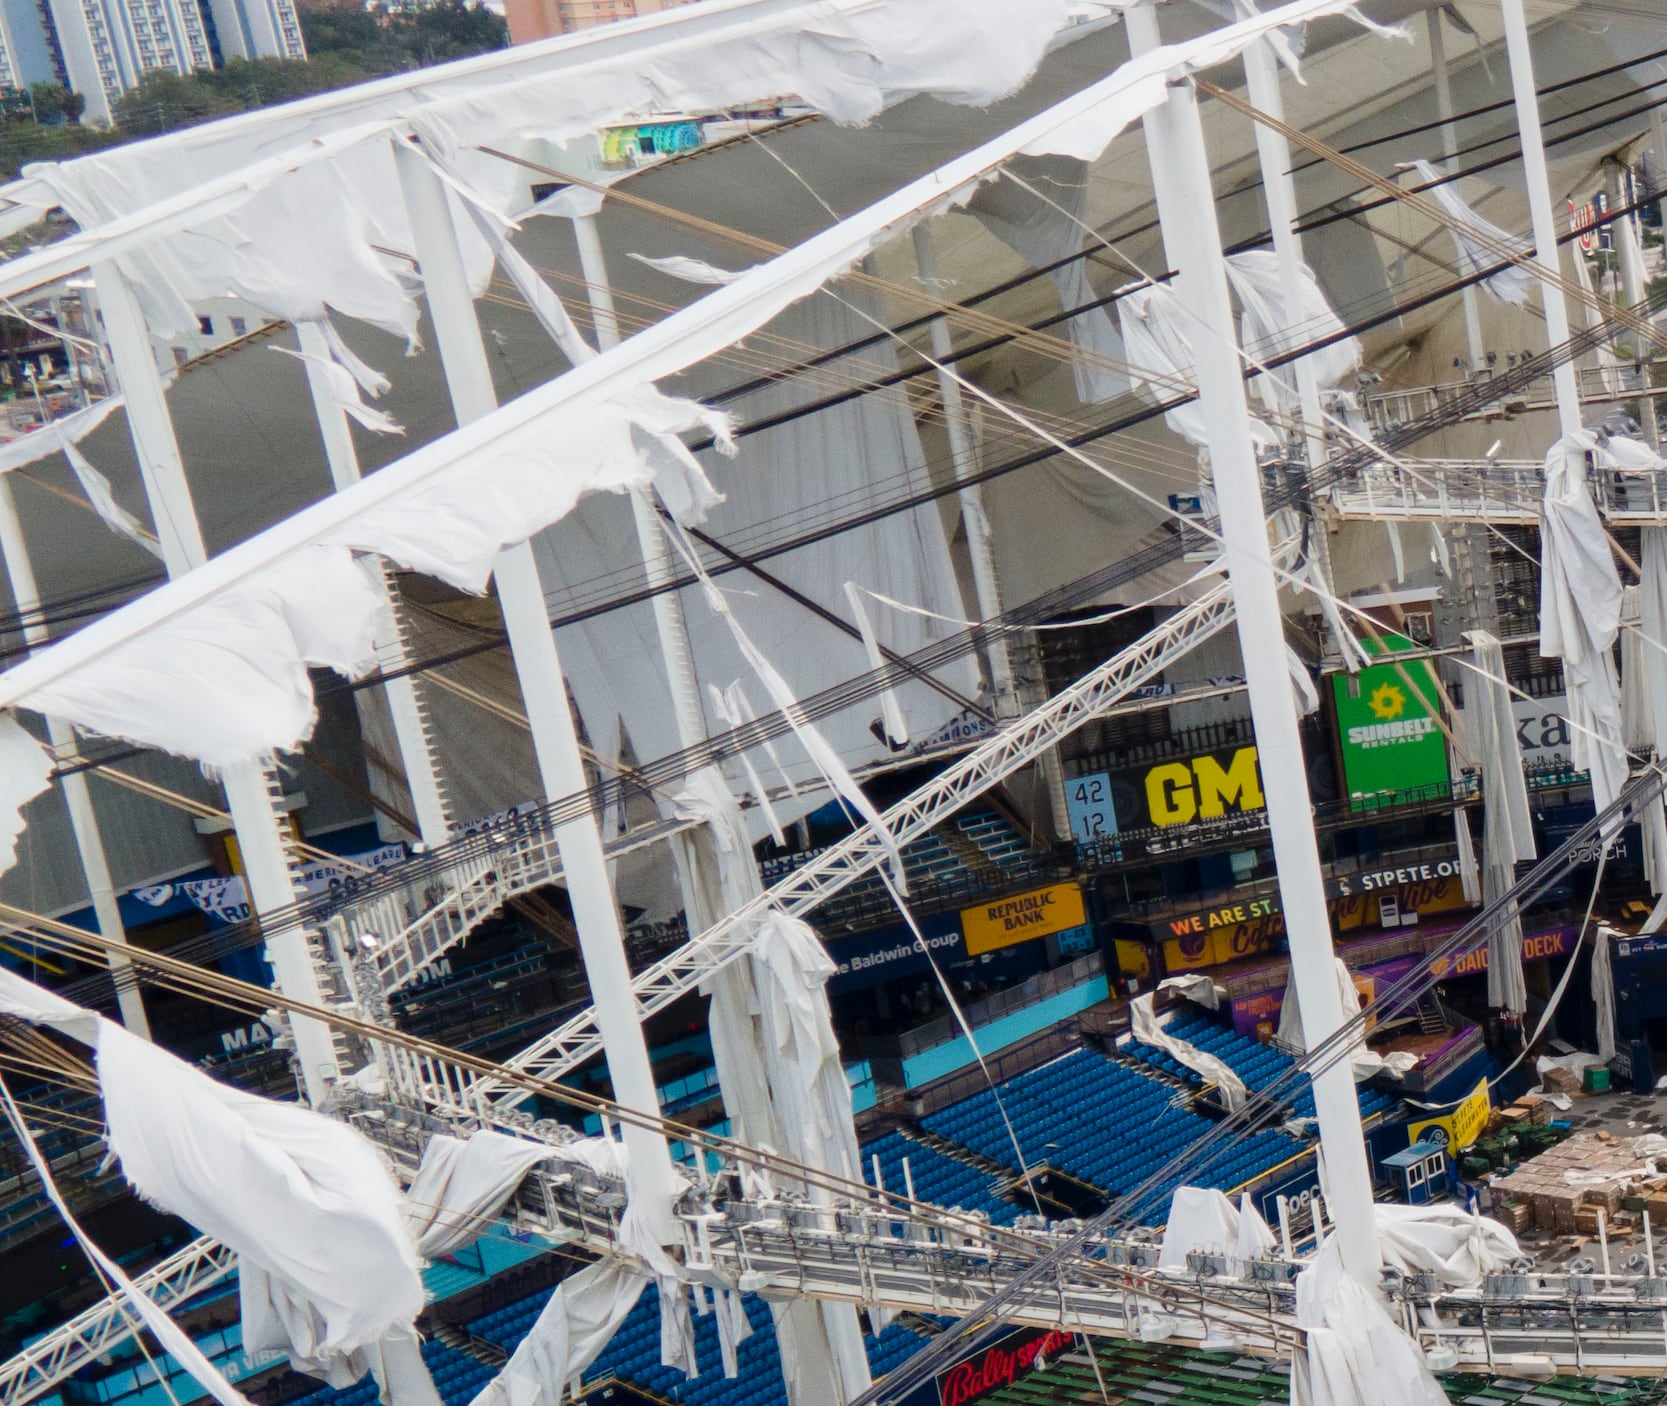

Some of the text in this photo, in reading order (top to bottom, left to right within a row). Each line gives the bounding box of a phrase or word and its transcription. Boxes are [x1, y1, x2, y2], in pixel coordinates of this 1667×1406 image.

[1347, 717, 1436, 745] SUNBELT
[1361, 734, 1424, 749] RENTALS
[1075, 779, 1104, 806] 42
[1144, 746, 1265, 829] GM
[987, 890, 1056, 921] REPUBLIC
[1004, 908, 1045, 931] BANK
[1170, 899, 1279, 936] WE ARE ST.
[851, 944, 911, 971] Baldwin
[913, 931, 960, 953] Group
[1524, 933, 1564, 959] DECK
